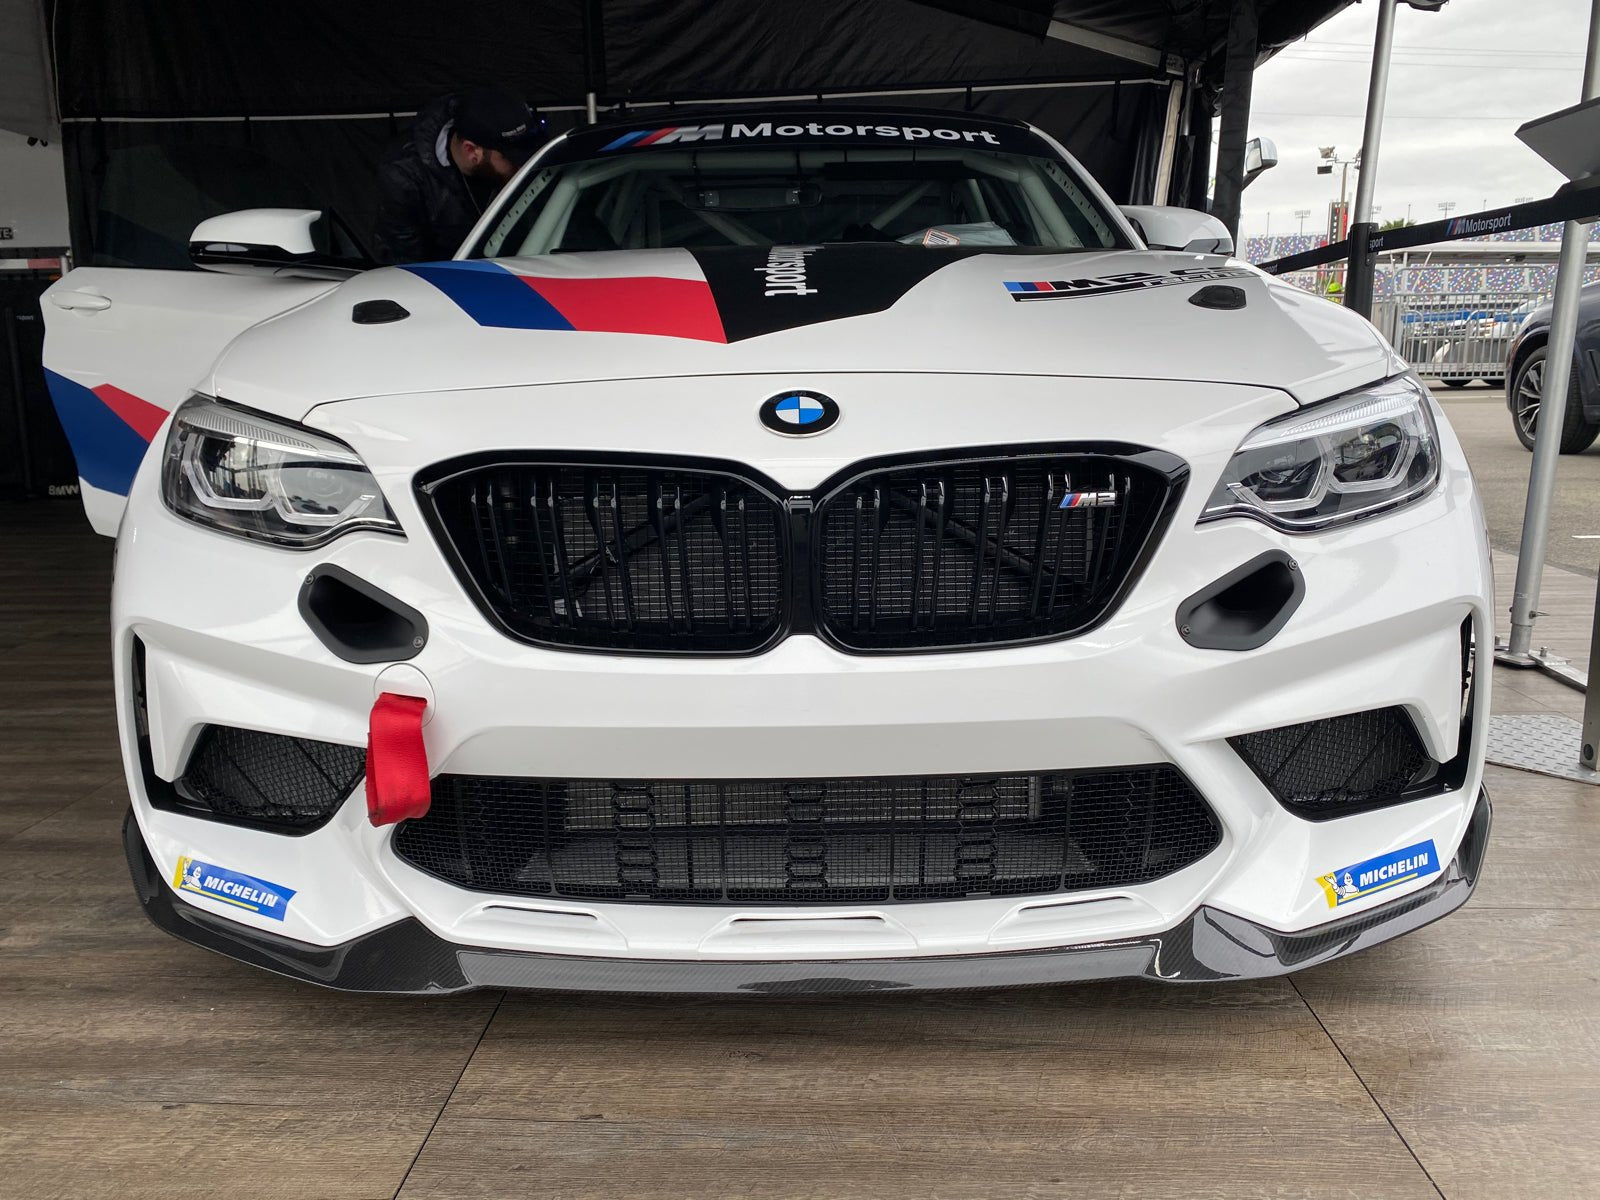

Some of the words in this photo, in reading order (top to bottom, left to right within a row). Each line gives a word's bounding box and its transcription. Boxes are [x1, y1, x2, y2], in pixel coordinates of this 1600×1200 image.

[730, 122, 1001, 145] Motorsport
[1465, 213, 1512, 233] Motorsport
[1074, 492, 1117, 507] M2
[1360, 852, 1429, 887] MICHELIN
[203, 875, 279, 908] MICHELIN
